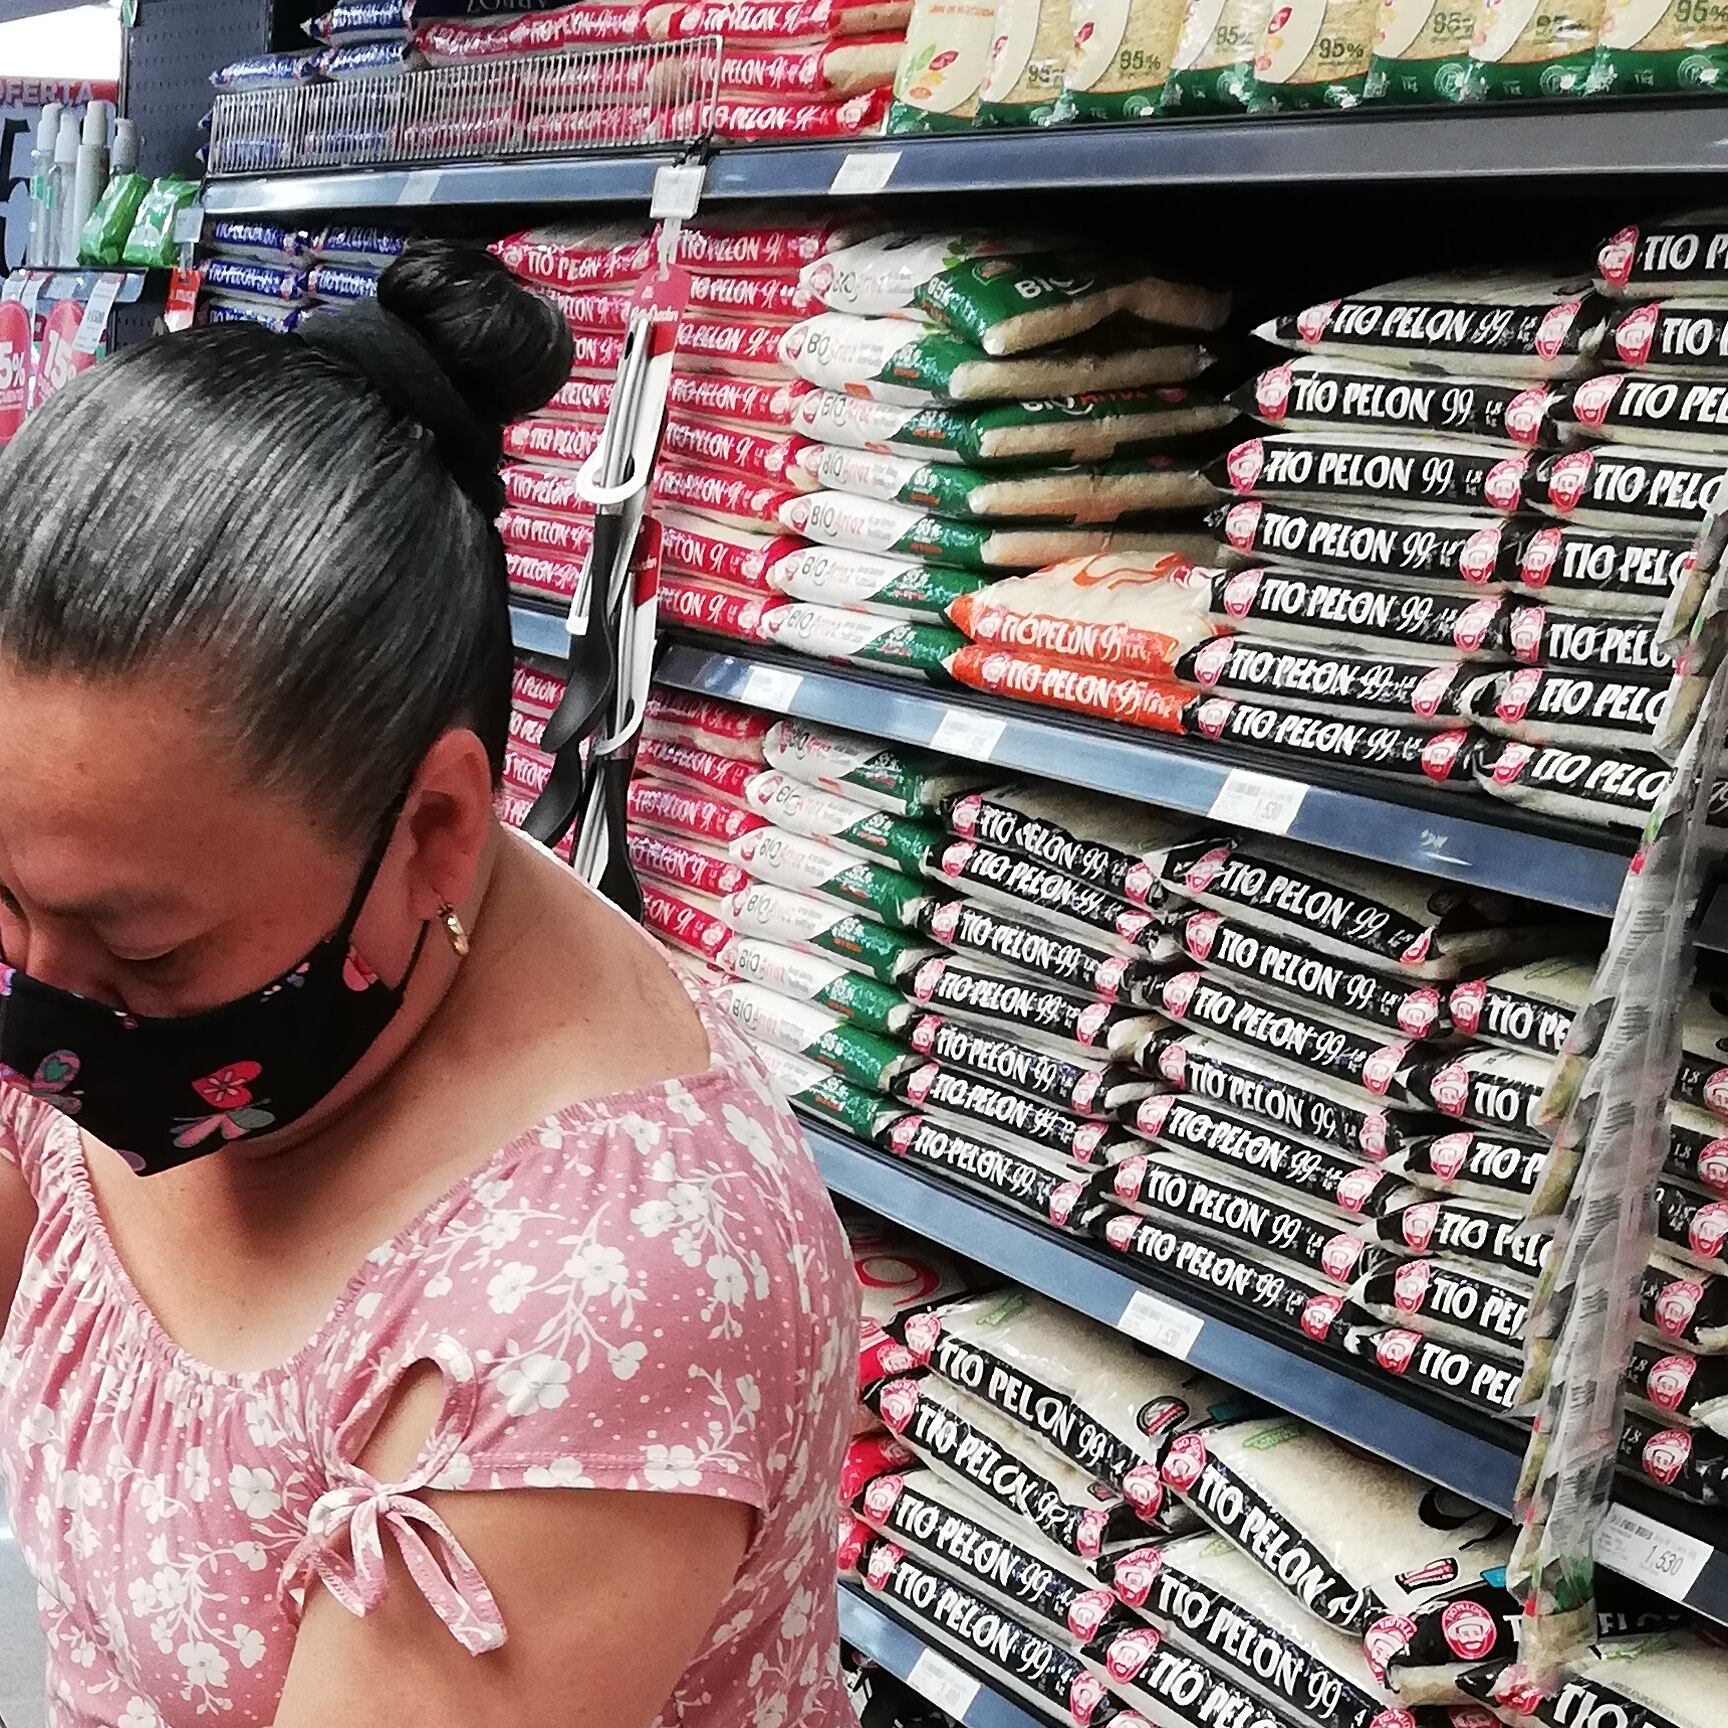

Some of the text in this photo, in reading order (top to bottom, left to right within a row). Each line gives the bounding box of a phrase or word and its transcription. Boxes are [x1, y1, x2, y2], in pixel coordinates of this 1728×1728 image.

[1643, 234, 1700, 271] TIO
[1662, 318, 1713, 356] TIO
[1619, 382, 1679, 419] TIO
[1263, 448, 1453, 495] TIO PELON 99
[1593, 464, 1647, 501] TIO
[1563, 542, 1615, 581] TIO
[1549, 623, 1595, 661] TIO
[1539, 678, 1593, 716] TIO
[1532, 749, 1589, 788] TIO
[1220, 859, 1390, 938] TIO PELON 99
[1217, 927, 1378, 1007] TIO PELON 99
[1487, 997, 1535, 1037] TIO
[1190, 1060, 1336, 1137] TIO PELON 99
[1474, 1081, 1518, 1122] TIO
[1198, 1461, 1335, 1613] TIO PELON
